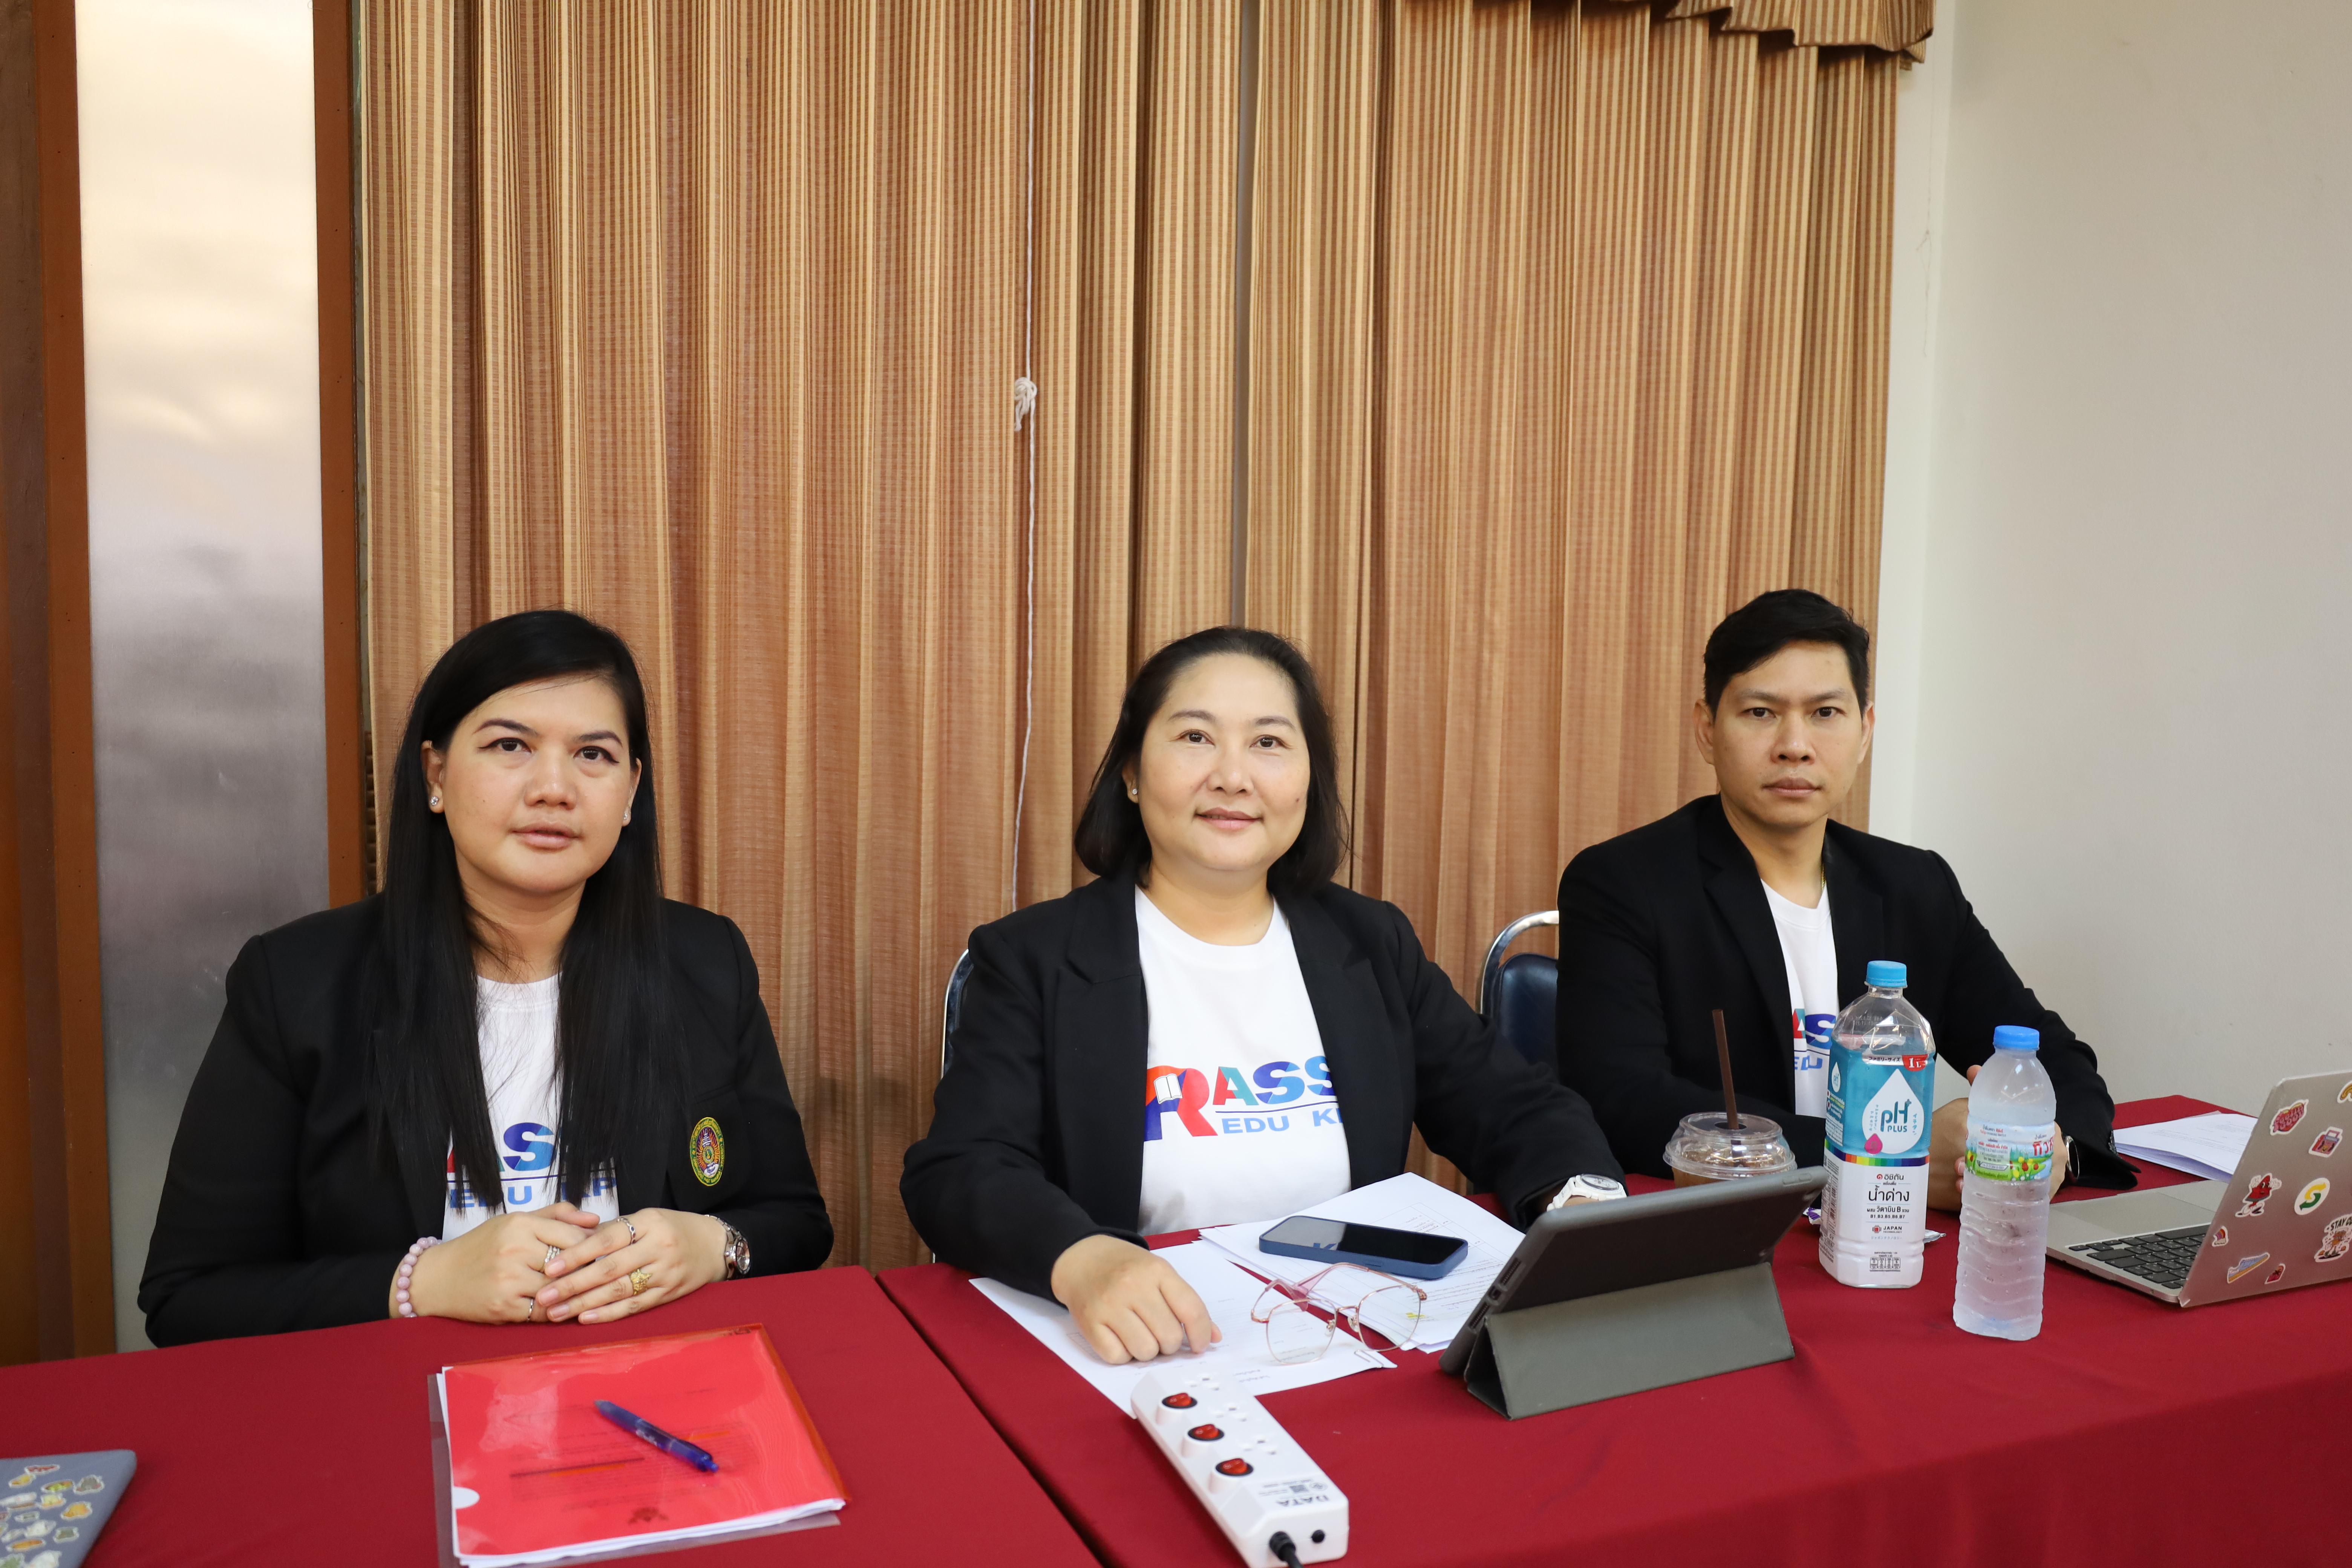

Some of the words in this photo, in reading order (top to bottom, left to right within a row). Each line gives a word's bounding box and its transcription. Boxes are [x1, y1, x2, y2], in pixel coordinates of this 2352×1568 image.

[1222, 1116, 1289, 1134] EDU
[1312, 1108, 1343, 1127] K
[1868, 1185, 1909, 1201] น้ำด่าง
[2330, 1217, 2347, 1231] STAY
